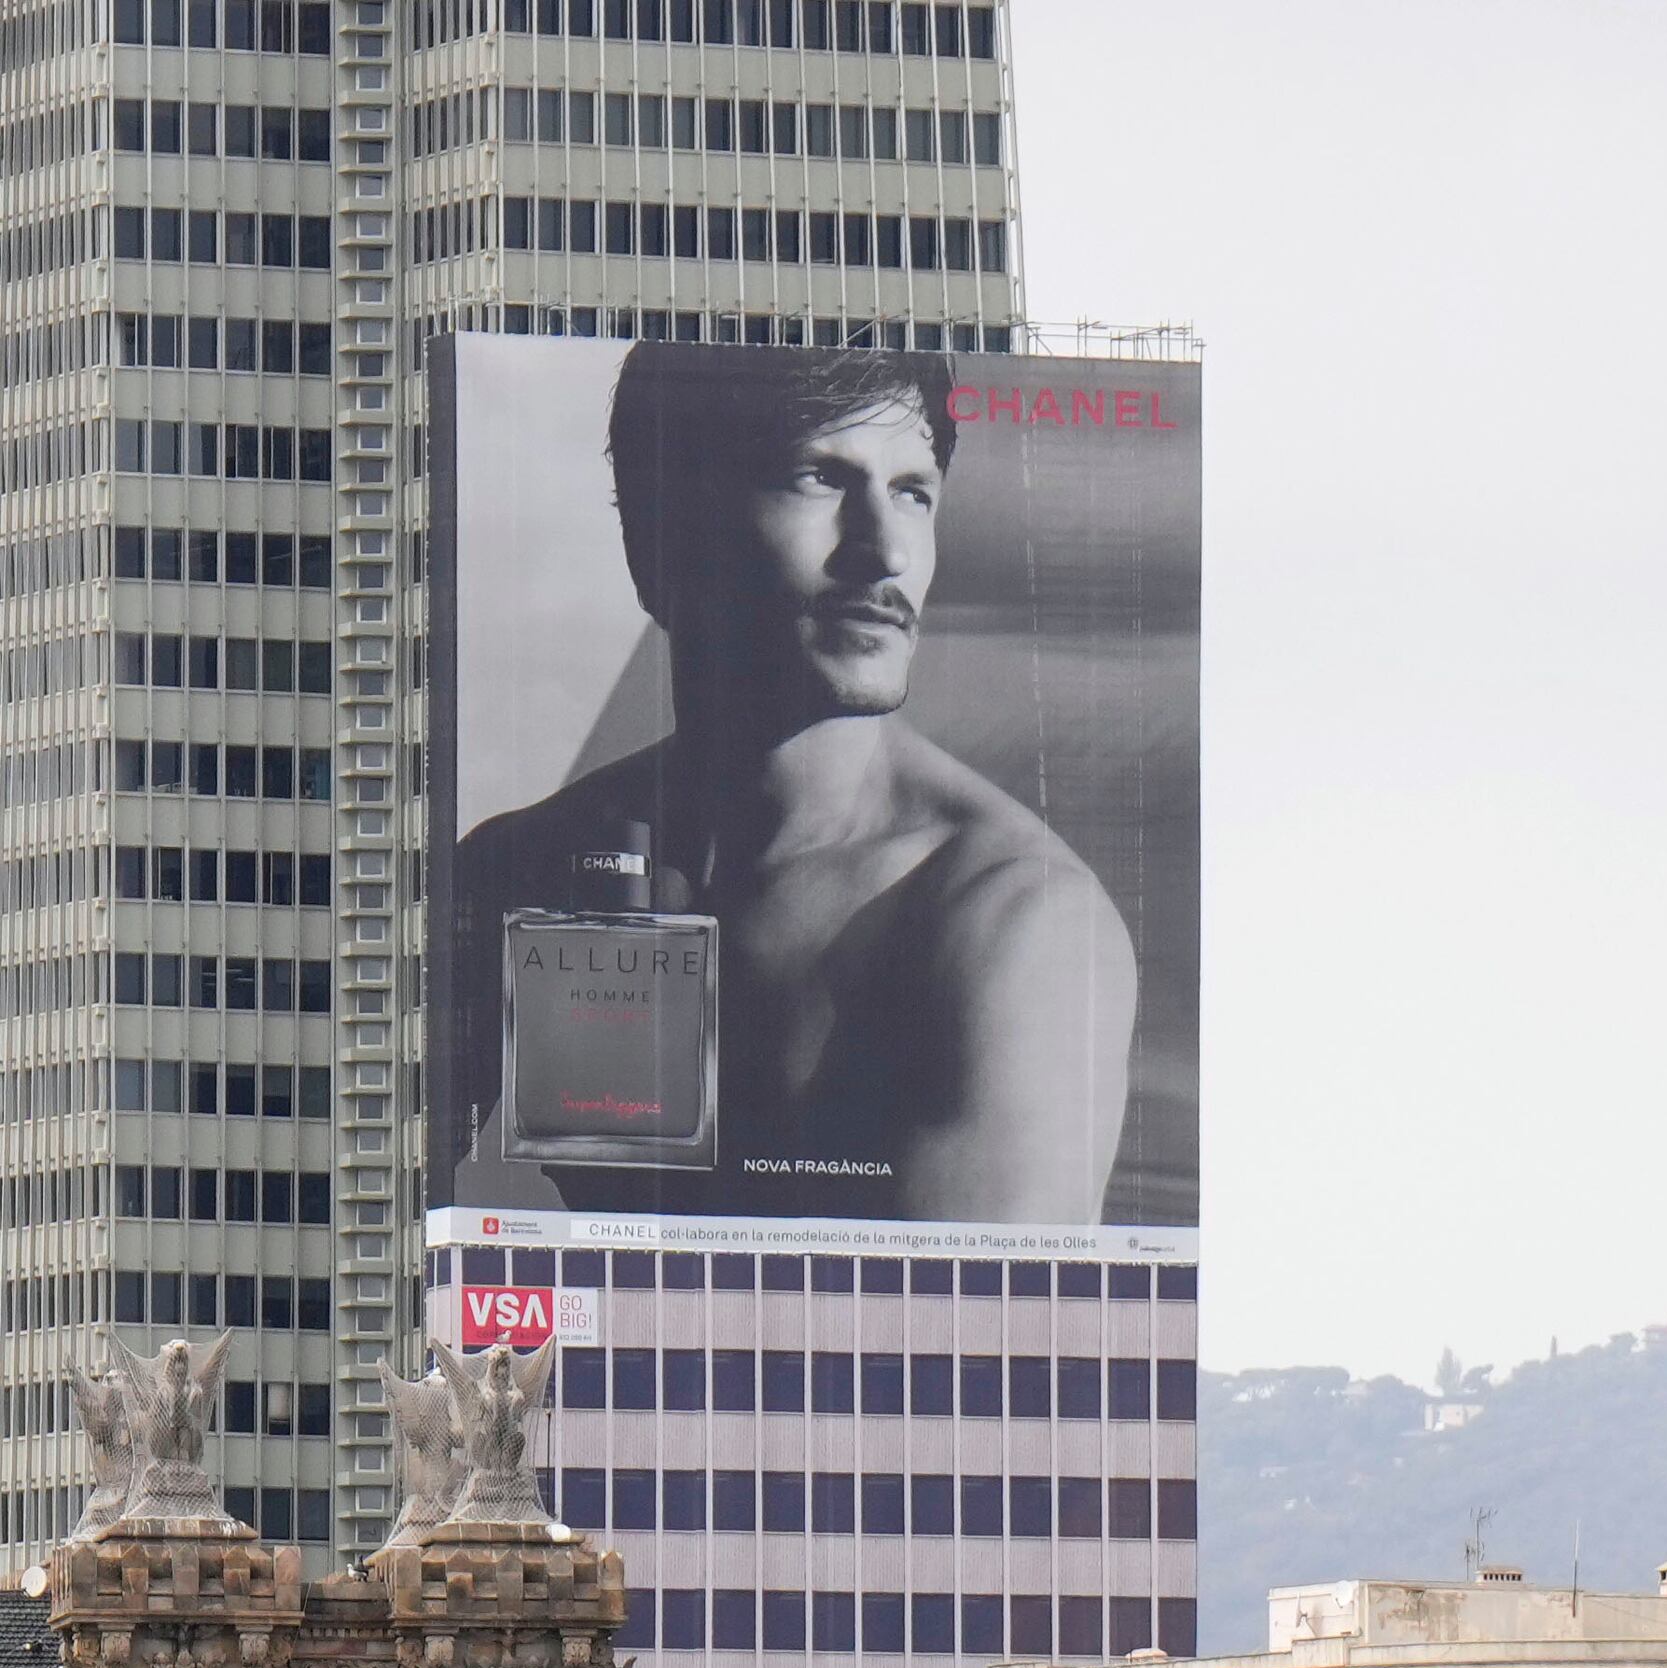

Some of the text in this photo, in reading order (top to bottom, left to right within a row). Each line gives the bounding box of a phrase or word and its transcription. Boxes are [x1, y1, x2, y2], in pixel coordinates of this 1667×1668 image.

[946, 386, 1178, 429] CHANEL
[523, 946, 699, 975] ALLURE
[570, 988, 650, 1003] HOMME
[744, 1158, 790, 1174] NOVA
[589, 1222, 655, 1238] CHANEL
[731, 1231, 747, 1241] en
[752, 1228, 764, 1241] la
[767, 1228, 850, 1243] remodelació
[853, 1231, 870, 1244] de
[873, 1231, 885, 1244] la
[889, 1233, 940, 1248] mitgera
[944, 1233, 961, 1246] de
[964, 1233, 976, 1247] la
[980, 1234, 1016, 1250] Plaça
[1019, 1235, 1036, 1248] de
[1039, 1235, 1059, 1248] les
[1062, 1236, 1096, 1249] Olles
[560, 1295, 582, 1310] GO
[560, 1312, 592, 1328] BIG!
